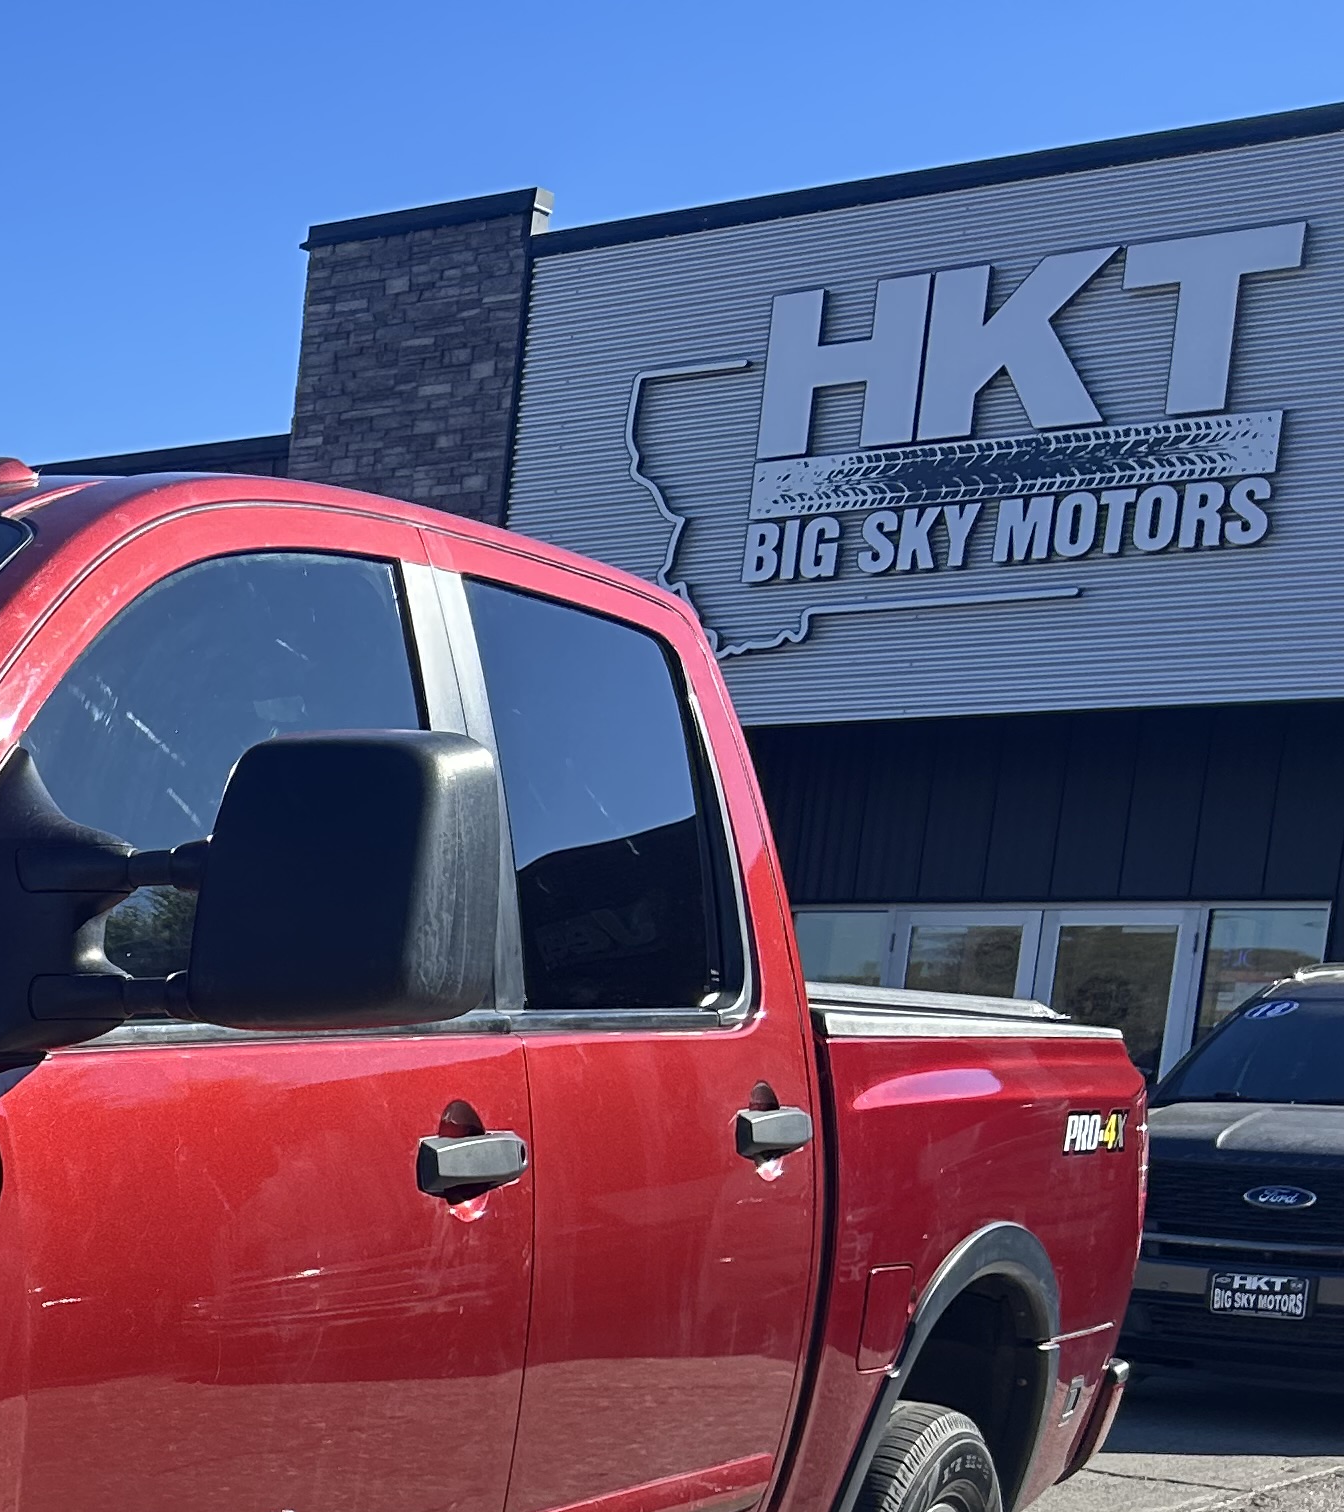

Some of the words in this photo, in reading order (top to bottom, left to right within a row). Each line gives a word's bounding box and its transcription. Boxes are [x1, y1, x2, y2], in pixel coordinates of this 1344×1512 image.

[756, 221, 1308, 460] HKT
[741, 515, 840, 583] BIG
[857, 501, 982, 576] SKY
[993, 476, 1272, 564] MOTORS
[1063, 1111, 1129, 1153] PRO-4X
[1258, 1189, 1300, 1205] Ford
[1232, 1275, 1289, 1292] HKT
[1213, 1287, 1232, 1309] BIG
[1234, 1291, 1256, 1309] SKY
[1257, 1292, 1304, 1316] MOTORS
